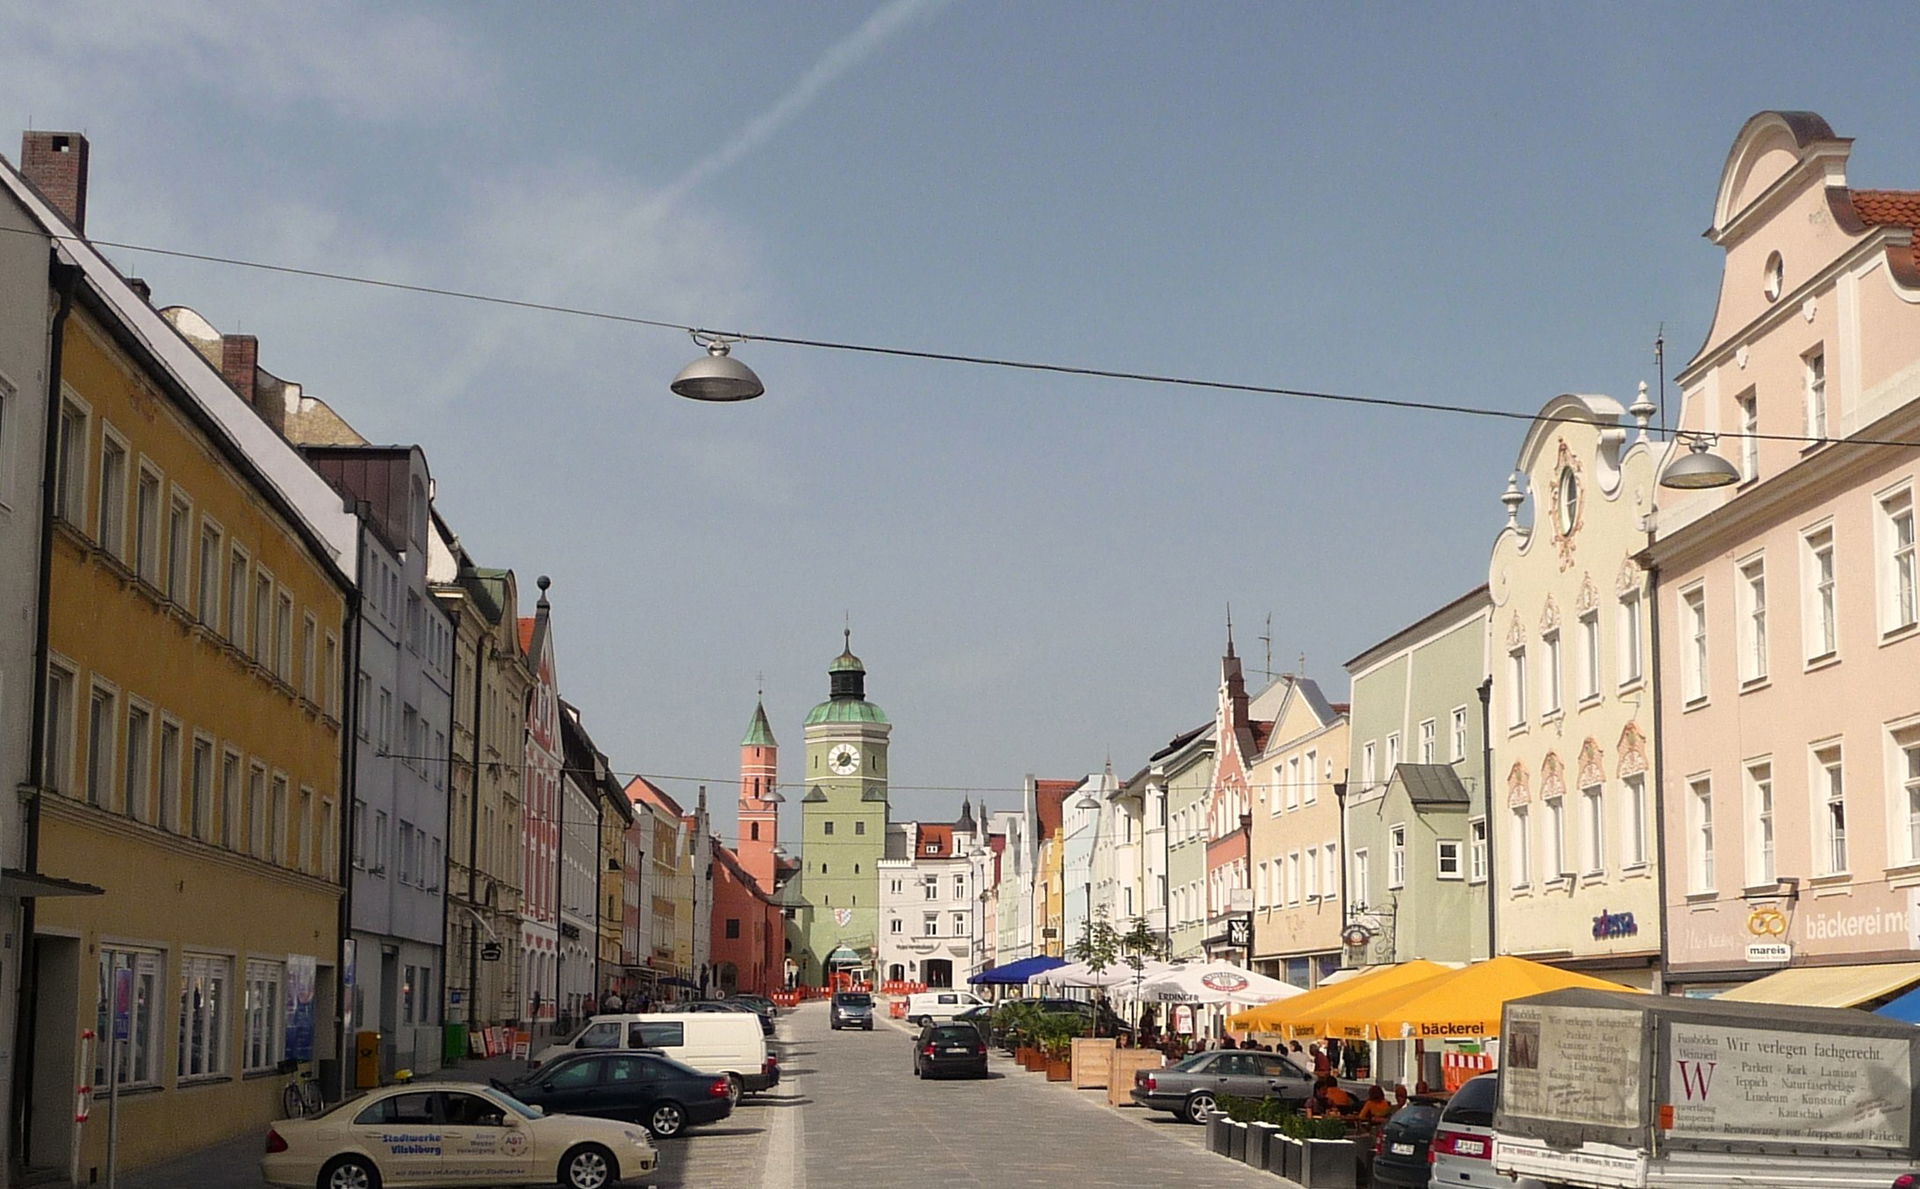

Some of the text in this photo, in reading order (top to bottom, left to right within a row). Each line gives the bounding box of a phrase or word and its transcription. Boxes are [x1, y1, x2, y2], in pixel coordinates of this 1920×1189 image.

[1806, 909, 1881, 939] bäckerei
[1750, 945, 1786, 954] mareis
[1158, 992, 1199, 1001] ERDINGER
[1421, 1022, 1485, 1035] bäckerei
[1726, 1036, 1750, 1052] Wir
[1758, 1040, 1807, 1059] verlegen
[1742, 1062, 1857, 1078] Parkett Kork Laminat
[1676, 1060, 1718, 1101] W
[1736, 1076, 1856, 1094] Teppich Naturfaserbeläge
[1745, 1091, 1846, 1106] Linoleum Kunststoff
[1778, 1108, 1824, 1119] Kautschuk
[383, 1133, 442, 1142] Stadtwerke
[1723, 1124, 1780, 1138] Renovierung
[1806, 1128, 1843, 1141] Treppen
[1846, 1130, 1864, 1140] und
[506, 1137, 522, 1145] AST
[391, 1145, 442, 1156] Vilsbiburg
